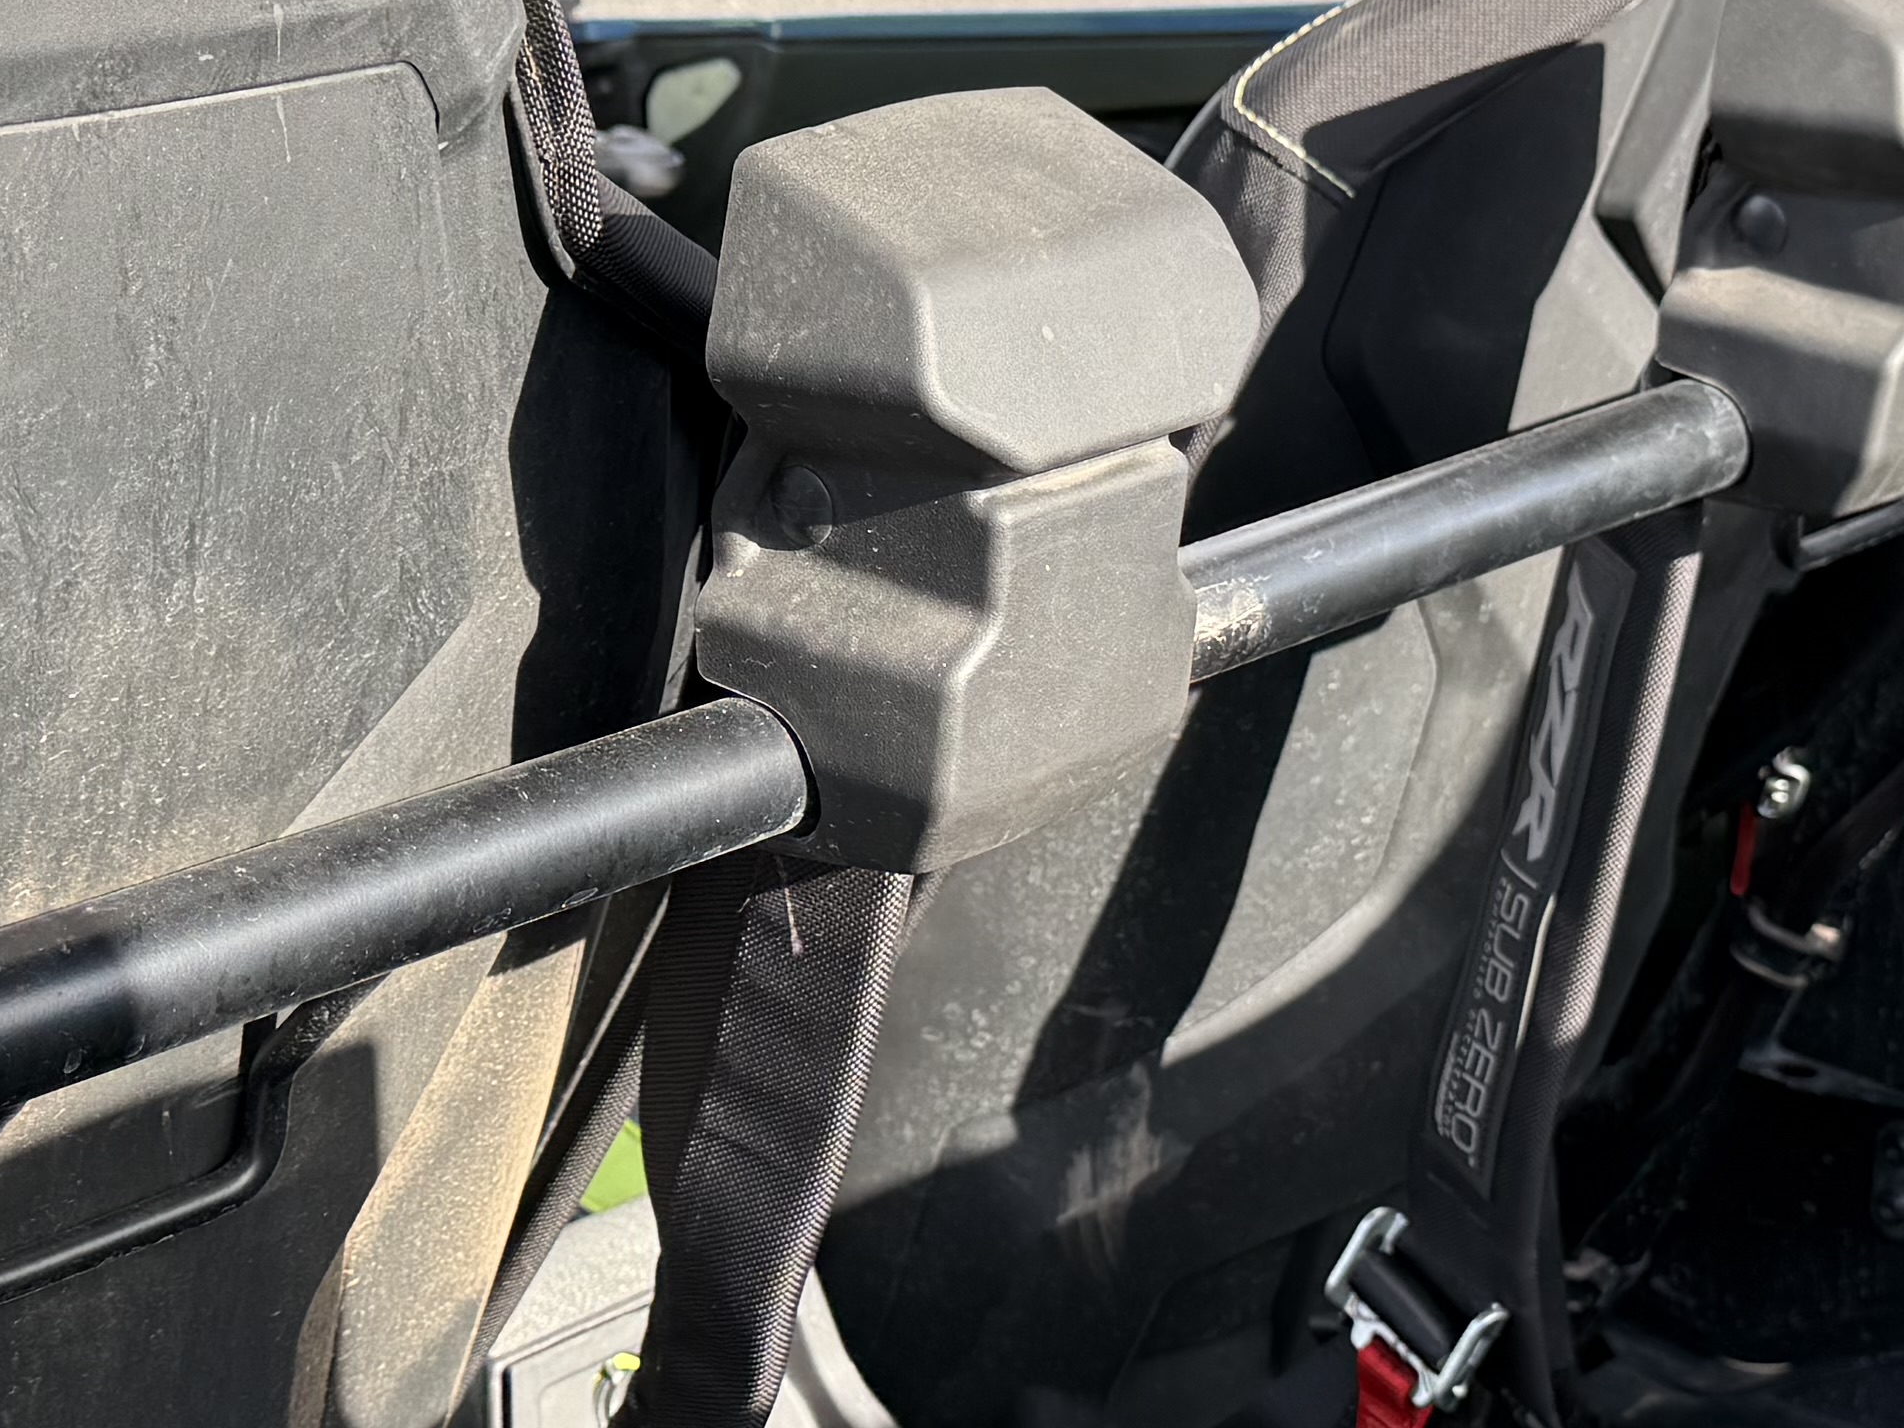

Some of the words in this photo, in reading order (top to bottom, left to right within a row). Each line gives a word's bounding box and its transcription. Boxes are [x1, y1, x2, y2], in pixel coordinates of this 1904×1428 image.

[1512, 561, 1594, 861] RZR
[1484, 883, 1530, 1003] SUB
[1451, 1008, 1503, 1154] ZERO
